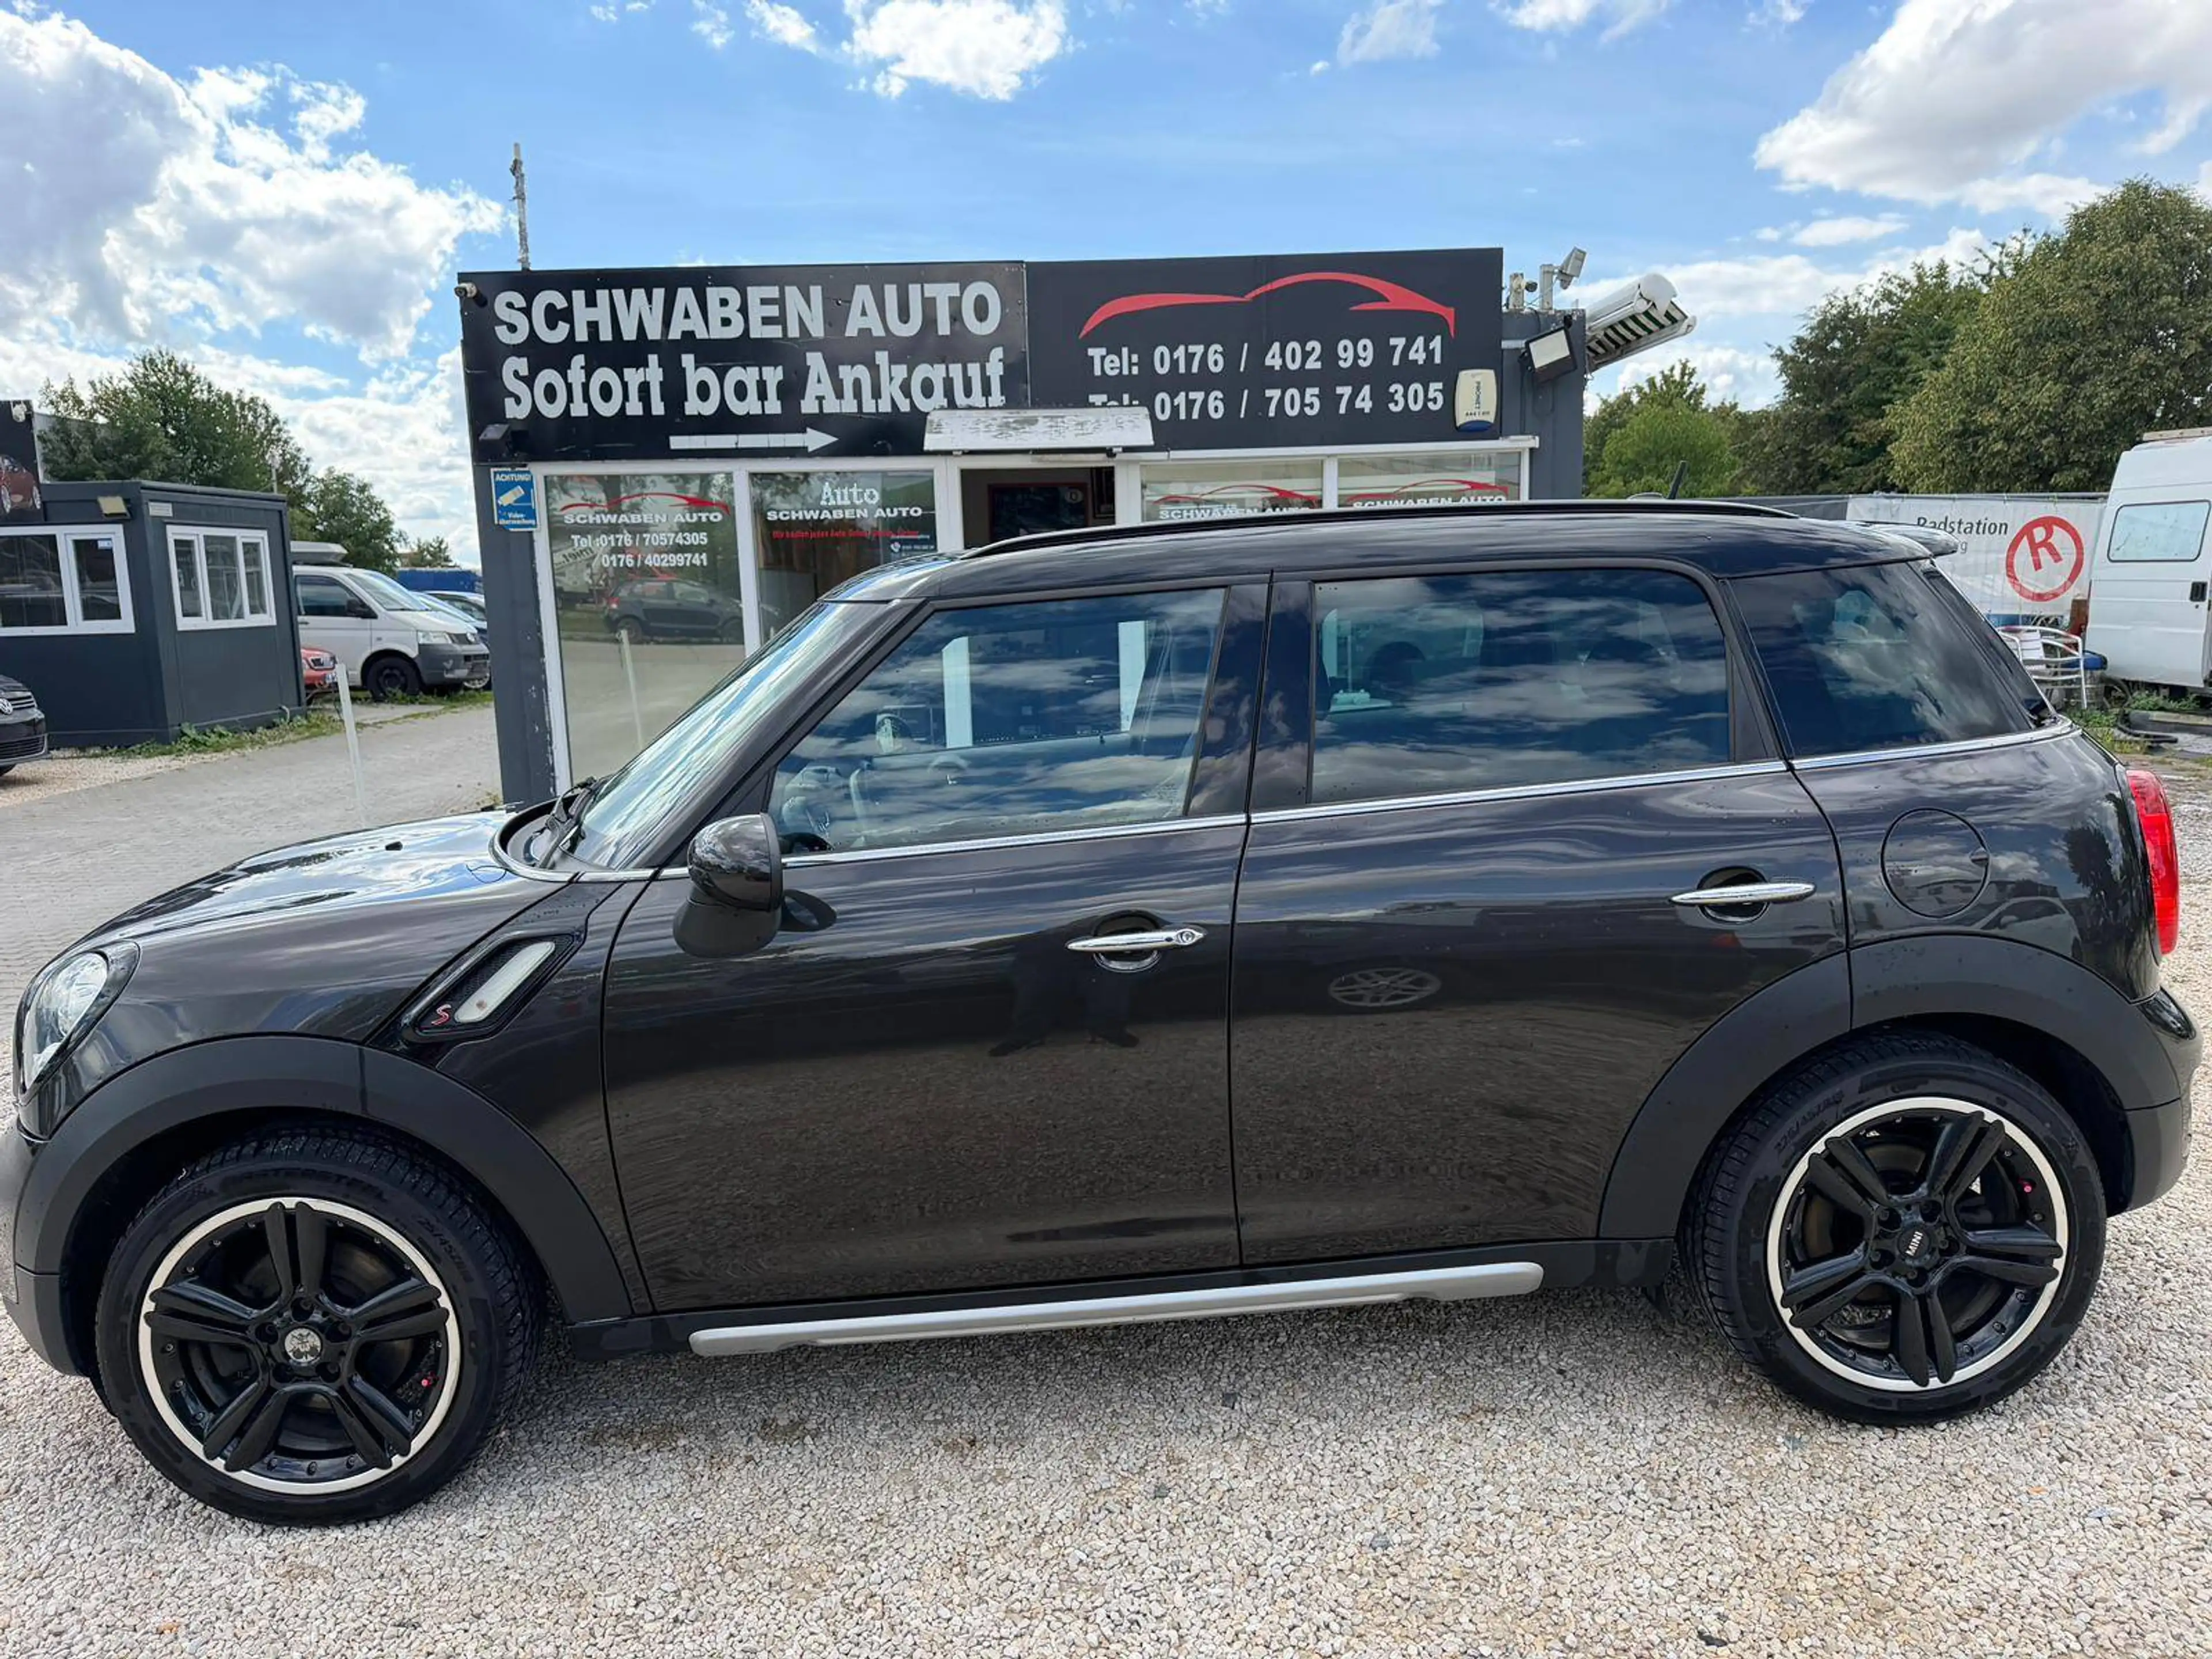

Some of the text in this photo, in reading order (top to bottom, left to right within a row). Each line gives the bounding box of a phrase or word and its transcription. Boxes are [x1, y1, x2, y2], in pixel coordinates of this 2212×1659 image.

[494, 281, 1001, 344] SCHWABEN AUTO
[1088, 335, 1441, 376] Tel: 0176 / 402 99 741
[502, 347, 1006, 419] Sofort bar Ankauf
[1154, 391, 1224, 421] 0176
[1240, 389, 1248, 418] /
[1265, 387, 1320, 417] 705
[1336, 384, 1372, 414] 74
[1388, 382, 1444, 412] 305
[820, 482, 880, 505] Auto
[564, 512, 722, 524] SCHWABEN AUTO
[767, 507, 922, 521] SCHWABEN AUTO
[1917, 516, 2009, 535] Radstation
[643, 533, 708, 546] 70574305
[601, 554, 634, 568] 0176
[645, 553, 708, 566] 40299741
[431, 1004, 452, 1025] S
[1905, 1230, 1923, 1256] MINI
